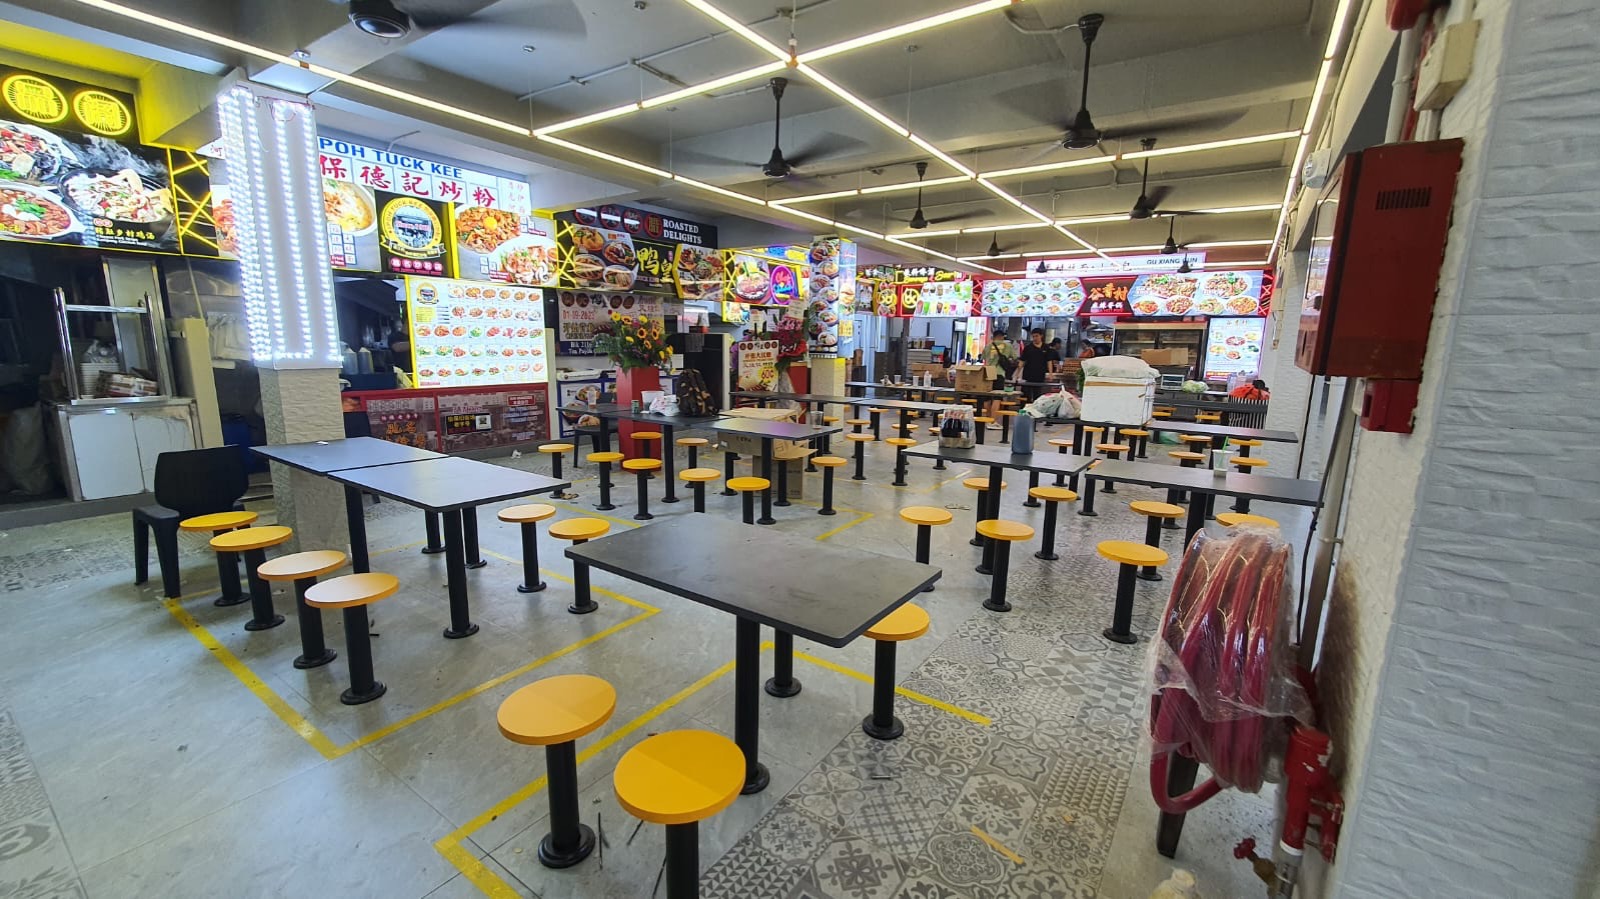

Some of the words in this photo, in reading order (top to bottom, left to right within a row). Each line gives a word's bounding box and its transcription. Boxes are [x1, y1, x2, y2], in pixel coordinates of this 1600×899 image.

[320, 138, 364, 158] POH
[372, 150, 424, 171] TUCK
[431, 163, 462, 179] KEE
[319, 155, 496, 207] 保德記炒粉
[663, 218, 700, 234] ROASTED
[663, 229, 703, 245] DELIGHTS
